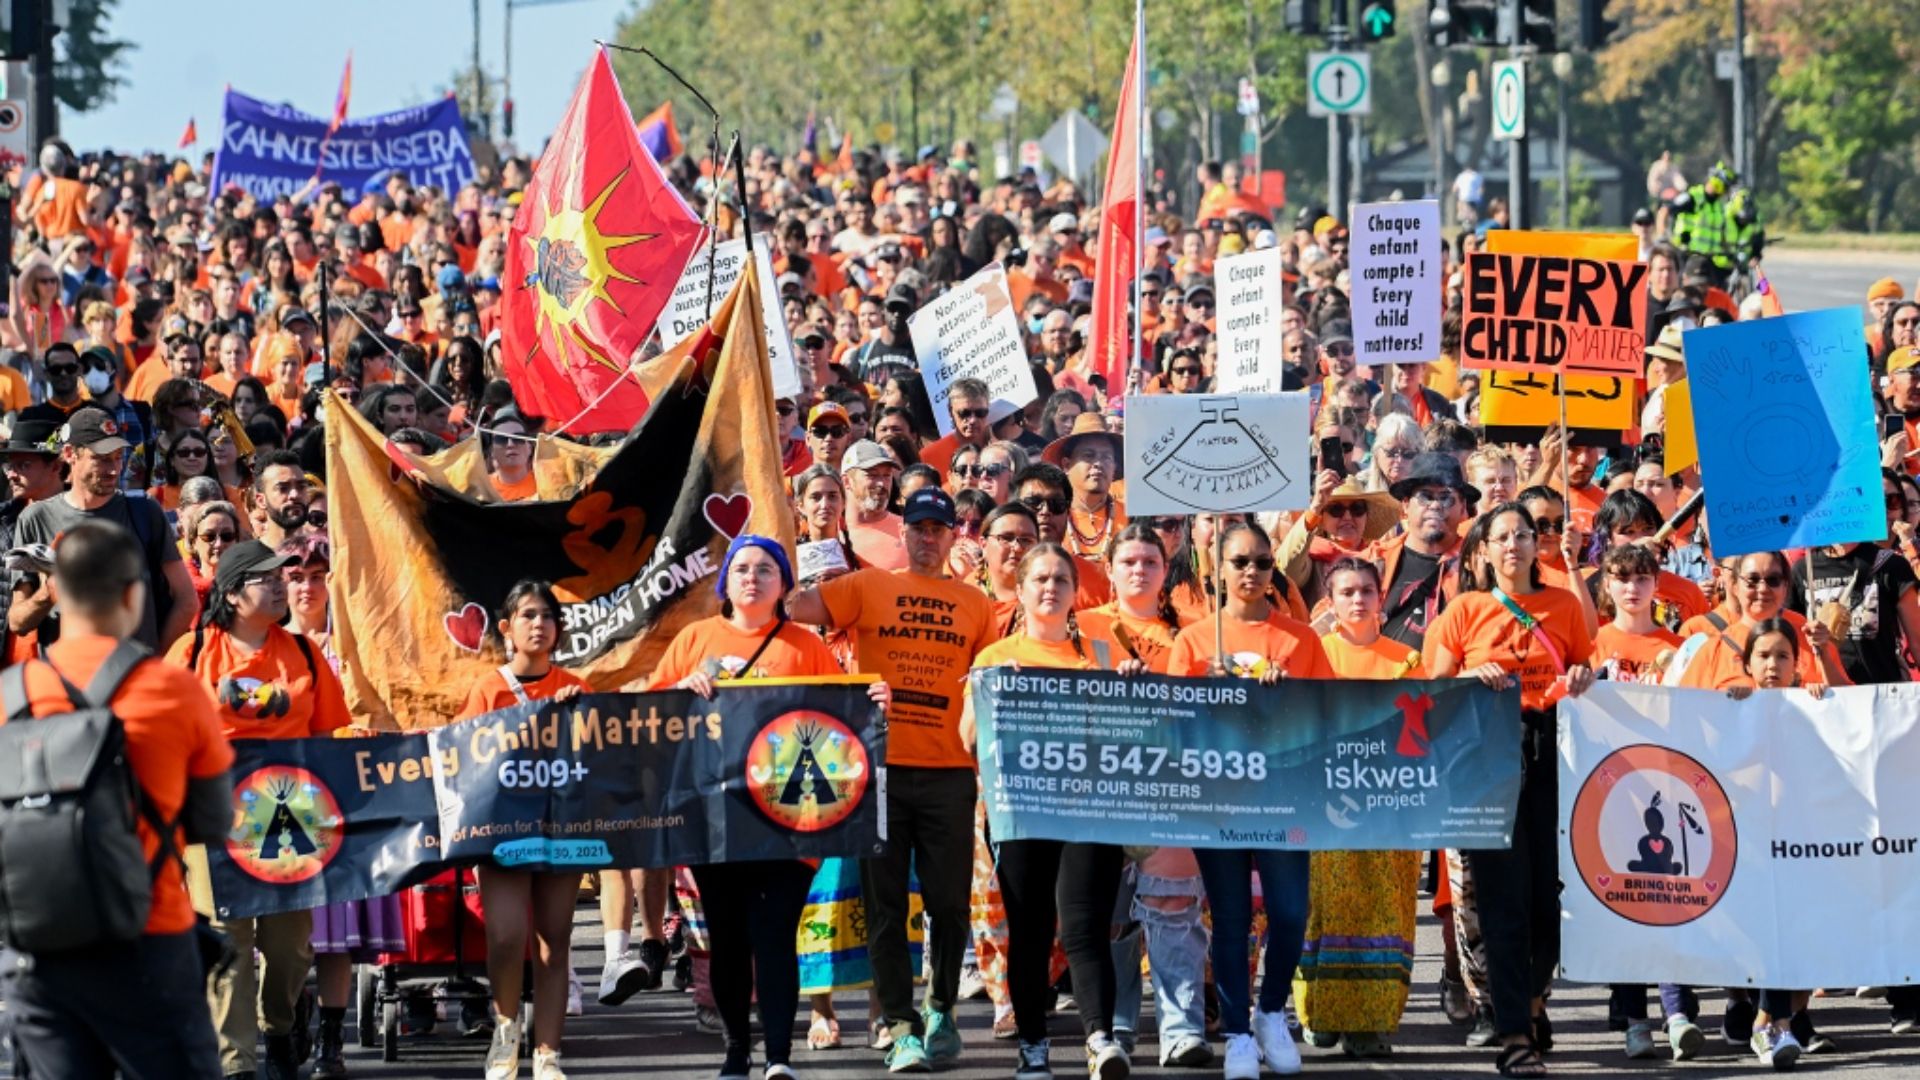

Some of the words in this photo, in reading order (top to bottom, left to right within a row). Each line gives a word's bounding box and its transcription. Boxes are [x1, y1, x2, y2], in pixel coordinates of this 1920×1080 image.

[223, 121, 471, 170] KAHNISTENSERA
[1368, 214, 1421, 234] Chaque
[1370, 239, 1418, 256] enfant
[1229, 263, 1265, 283] Chaque
[1363, 263, 1414, 285] compte
[1420, 260, 1425, 277] !
[1230, 286, 1263, 306] enfant
[1372, 286, 1412, 307] Every
[1469, 254, 1648, 329] EVERY
[935, 299, 957, 320] Non
[938, 302, 984, 337] attaques
[1375, 309, 1409, 328] child
[1227, 310, 1261, 331] compte
[936, 327, 977, 360] racistes
[965, 327, 1007, 362] colonial
[1234, 336, 1260, 354] Every
[1364, 333, 1423, 353] matters!
[1464, 317, 1567, 365] CHILD
[982, 340, 1017, 369] contre
[1237, 357, 1258, 376] child
[1141, 427, 1176, 466] EVERY
[1250, 424, 1279, 458] CHILD
[1197, 436, 1238, 446] MATTERS
[1718, 496, 1790, 518] CHAQUE
[638, 547, 718, 609] HOME
[896, 595, 957, 613] EVERY
[900, 612, 953, 627] CHILD
[879, 626, 966, 648] MATTERS
[888, 651, 954, 669] ORANGE
[896, 664, 943, 677] SHIRT
[903, 676, 936, 688] DAY
[992, 676, 1070, 695] JUSTICE
[1077, 680, 1126, 698] POUR
[1132, 682, 1169, 700] NOS
[1172, 683, 1247, 704] SOEURS
[355, 743, 460, 792] Every
[470, 712, 559, 764] Child
[571, 707, 722, 751] Matters
[1336, 738, 1386, 758] projet
[988, 740, 1003, 768] 1
[1018, 740, 1087, 773] 855
[1099, 744, 1267, 780] 547-5938
[499, 758, 589, 788] 6509+
[1325, 758, 1439, 789] iskweu
[994, 774, 1057, 791] JUSTICE
[1061, 779, 1092, 793] FOR
[1097, 780, 1130, 795] OUR
[1134, 782, 1201, 798] SISTERS
[1366, 791, 1426, 811] project
[453, 829, 466, 842] of
[470, 823, 512, 838] Action
[514, 820, 532, 833] for
[565, 820, 591, 833] and
[594, 815, 684, 832] Reconciliation
[1219, 829, 1286, 843] Montréal
[576, 846, 604, 858] 2021
[1771, 838, 1864, 859] Honour
[1871, 836, 1918, 856] Our
[1624, 879, 1664, 891] BRING
[1666, 882, 1691, 893] OUR
[1605, 891, 1671, 904] CHILDREN
[1672, 895, 1709, 906] HOME
